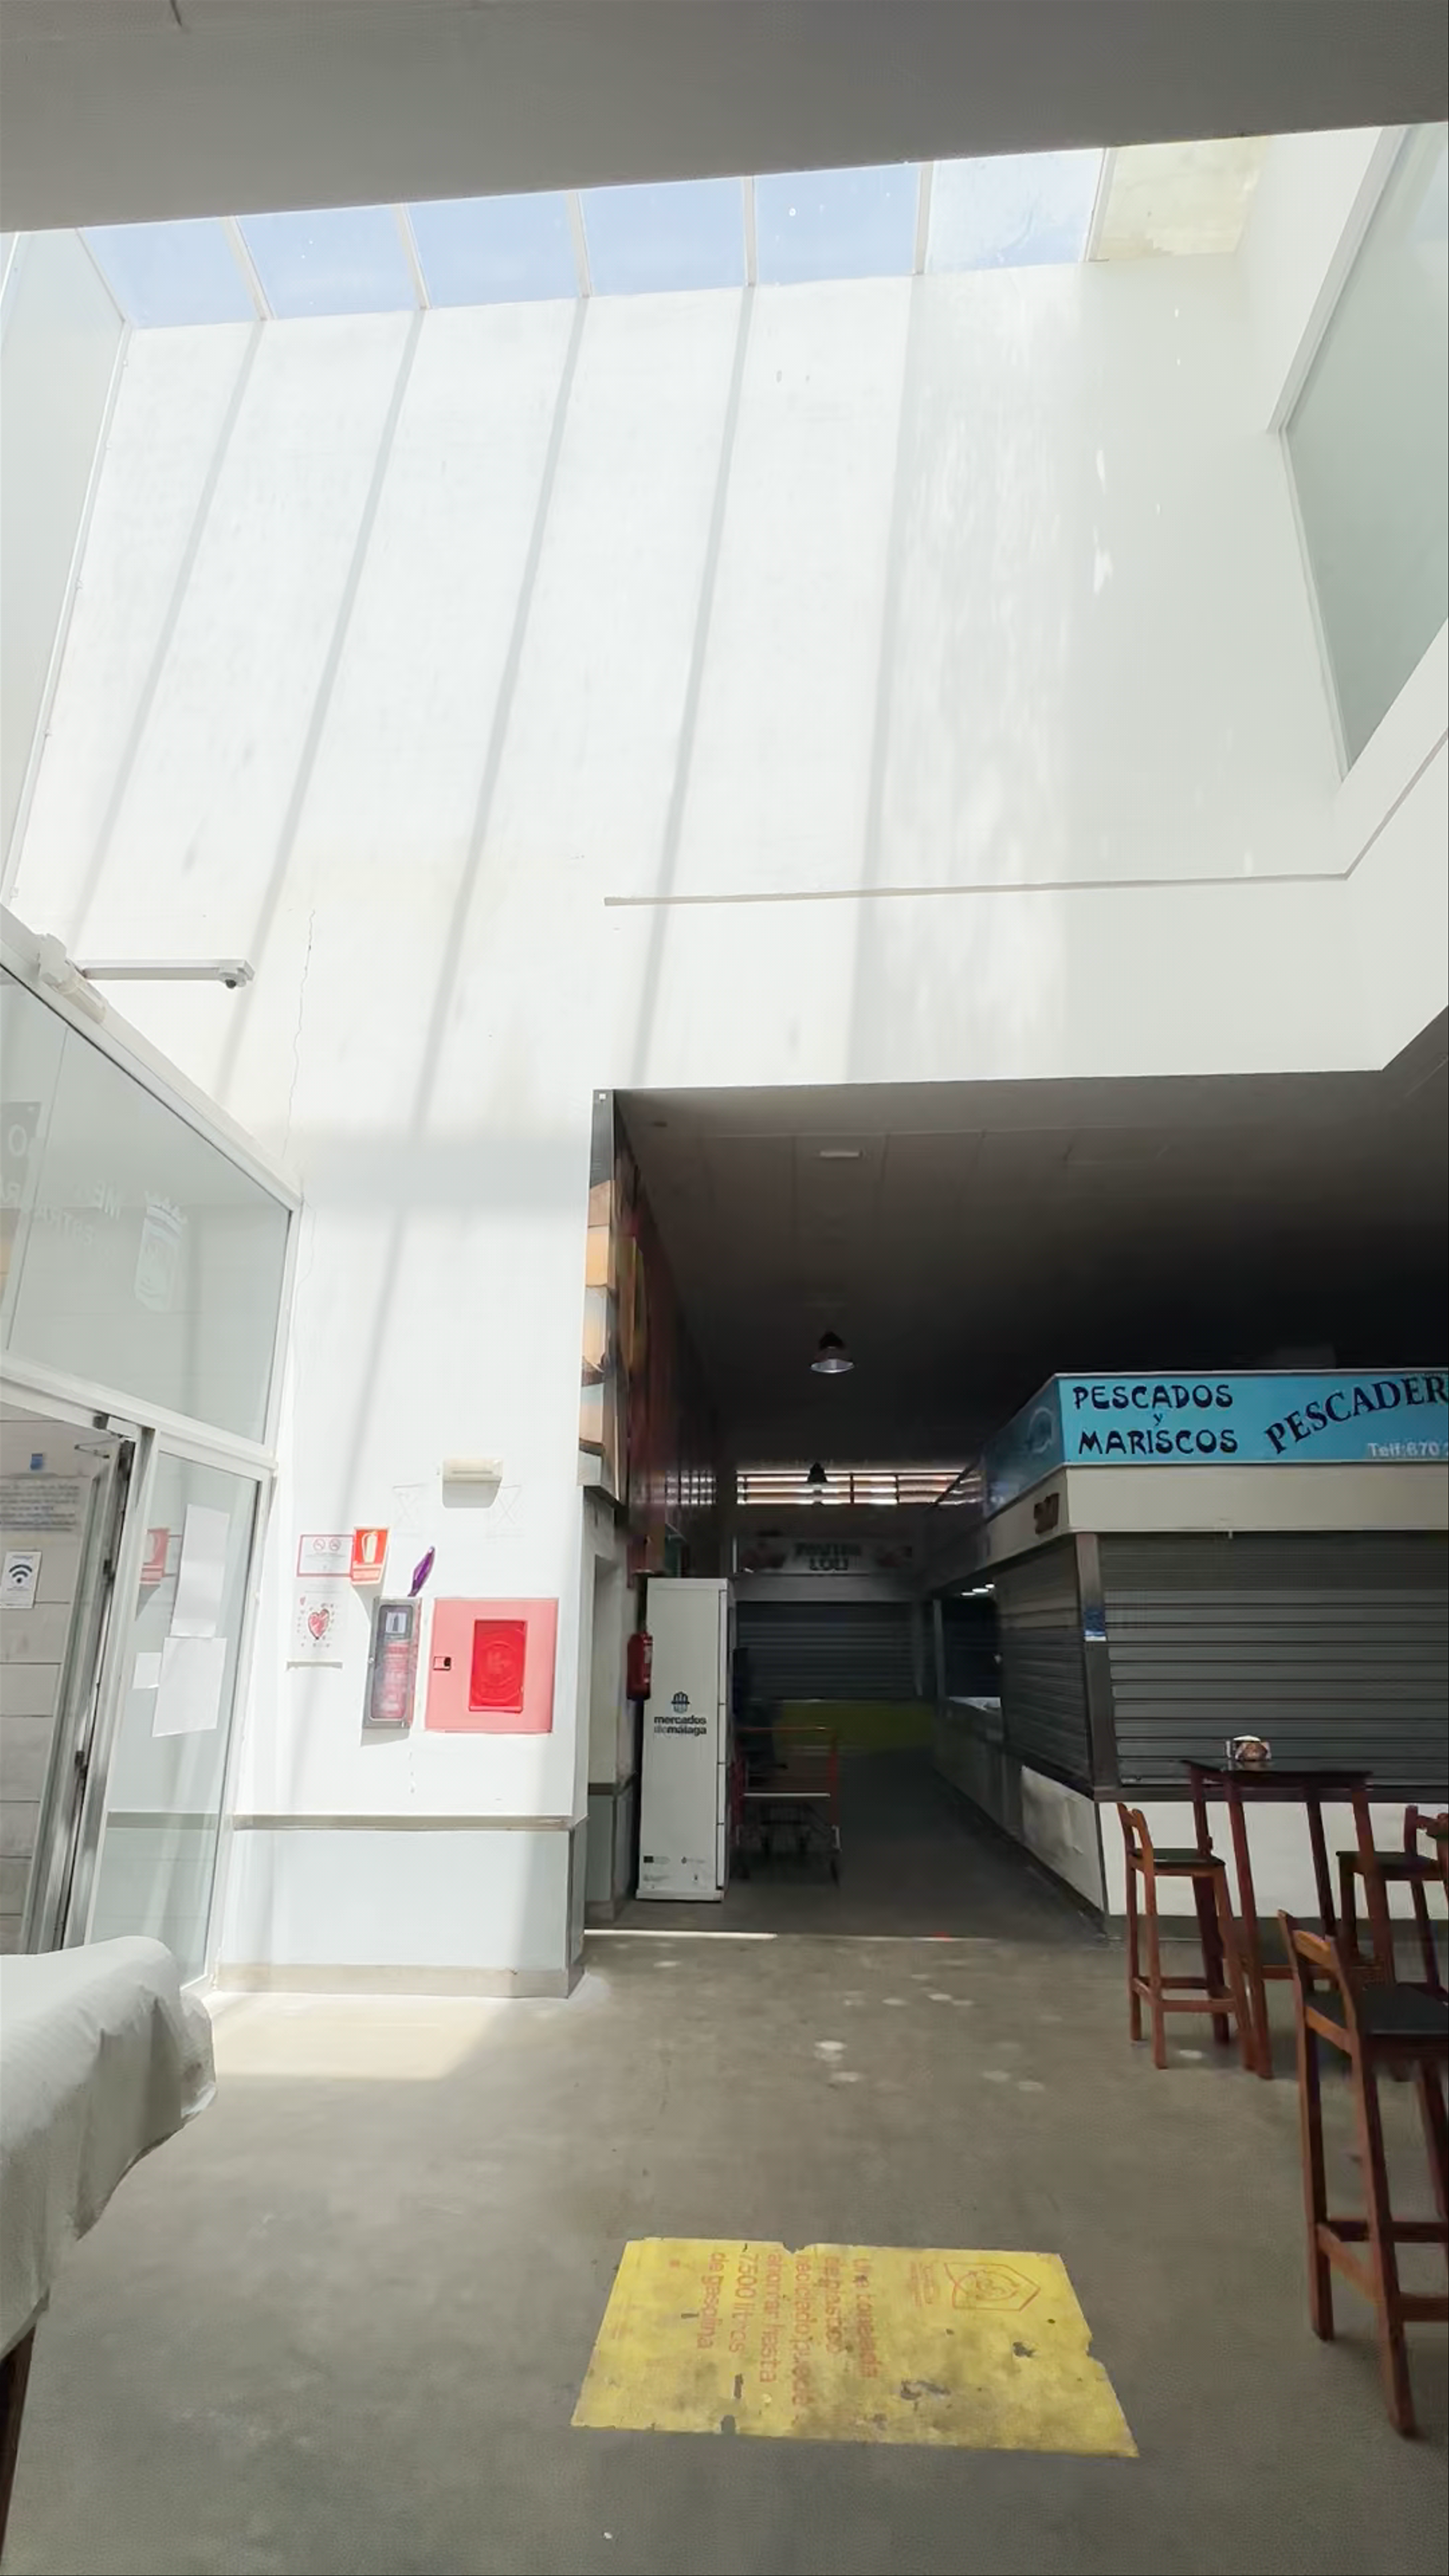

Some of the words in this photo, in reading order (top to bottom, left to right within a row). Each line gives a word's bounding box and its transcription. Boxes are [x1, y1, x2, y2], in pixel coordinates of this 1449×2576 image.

[1072, 1384, 1233, 1410] PESCADOS
[1078, 1429, 1238, 1455] MARISCOS
[654, 1715, 707, 1725] mercados
[708, 2252, 730, 2272] de
[764, 2253, 783, 2319] ahorrar
[697, 2275, 724, 2350] gasolina
[760, 2324, 785, 2383] hasta
